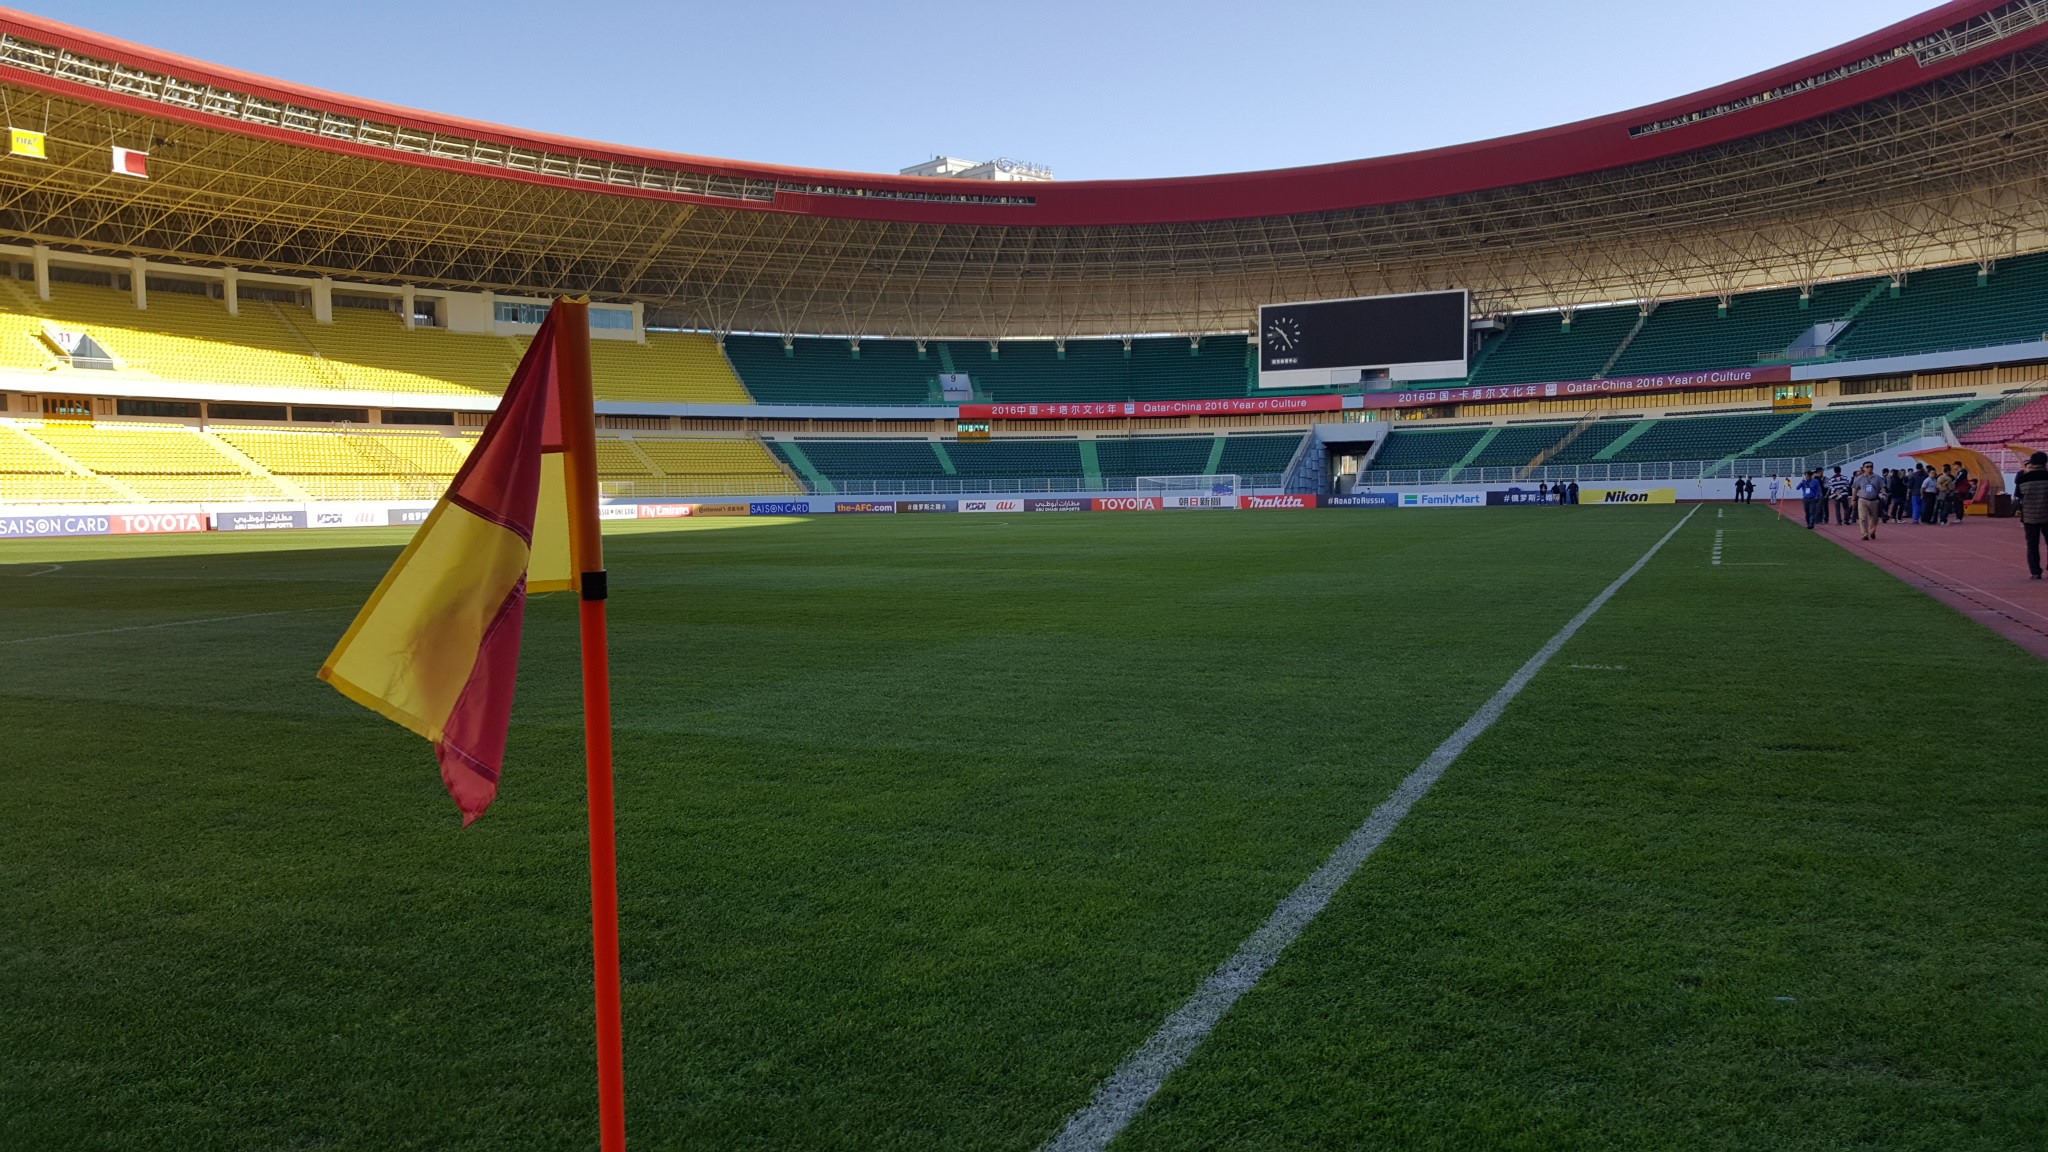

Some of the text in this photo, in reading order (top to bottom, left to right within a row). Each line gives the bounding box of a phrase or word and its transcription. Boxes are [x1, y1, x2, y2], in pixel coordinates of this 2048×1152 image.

[1829, 322, 1836, 333] 7
[59, 332, 71, 343] 11
[950, 374, 957, 383] 9
[1567, 370, 1752, 393] Qatar-China 2016 Year of Culture
[1205, 402, 1229, 411] 2016
[1232, 400, 1256, 410] Year
[1258, 400, 1268, 409] of
[1271, 398, 1307, 408] Culture
[1421, 494, 1480, 505] FamilyMart
[1604, 491, 1649, 503] Nikon
[751, 504, 784, 514] SAISON
[786, 503, 809, 513] CARD
[837, 503, 893, 512] the-AFC.com
[965, 501, 1017, 511] KDDI au
[1099, 498, 1155, 510] TOYOTA
[641, 506, 690, 518] Fly Emirates
[0, 517, 109, 535] SAISON CARD
[122, 515, 201, 533] TOYOTA
